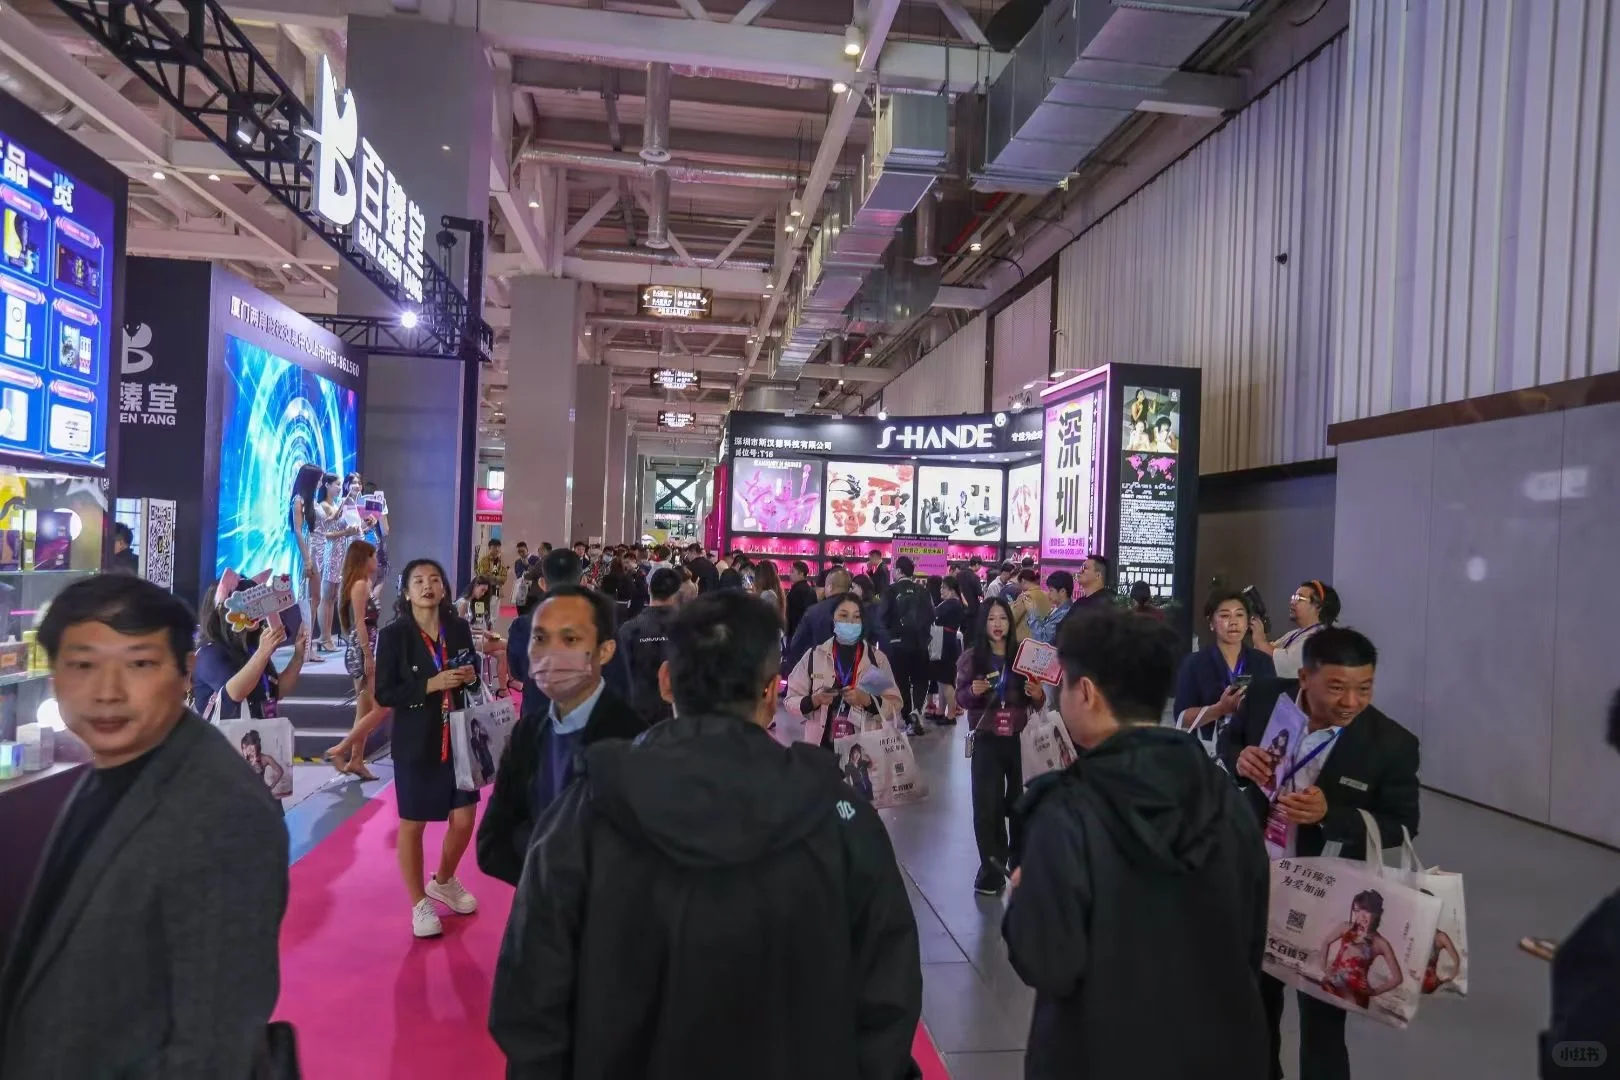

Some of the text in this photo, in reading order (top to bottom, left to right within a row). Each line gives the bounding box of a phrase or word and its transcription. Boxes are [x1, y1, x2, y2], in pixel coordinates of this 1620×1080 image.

[359, 217, 423, 304] BAI ZHEN TANG
[141, 413, 176, 425] TANG
[733, 436, 832, 451] 深圳市斯汉德科技有限公司
[877, 423, 993, 449] S-HANDE
[1055, 408, 1083, 534] 深圳
[1282, 875, 1327, 898] 为爱加油
